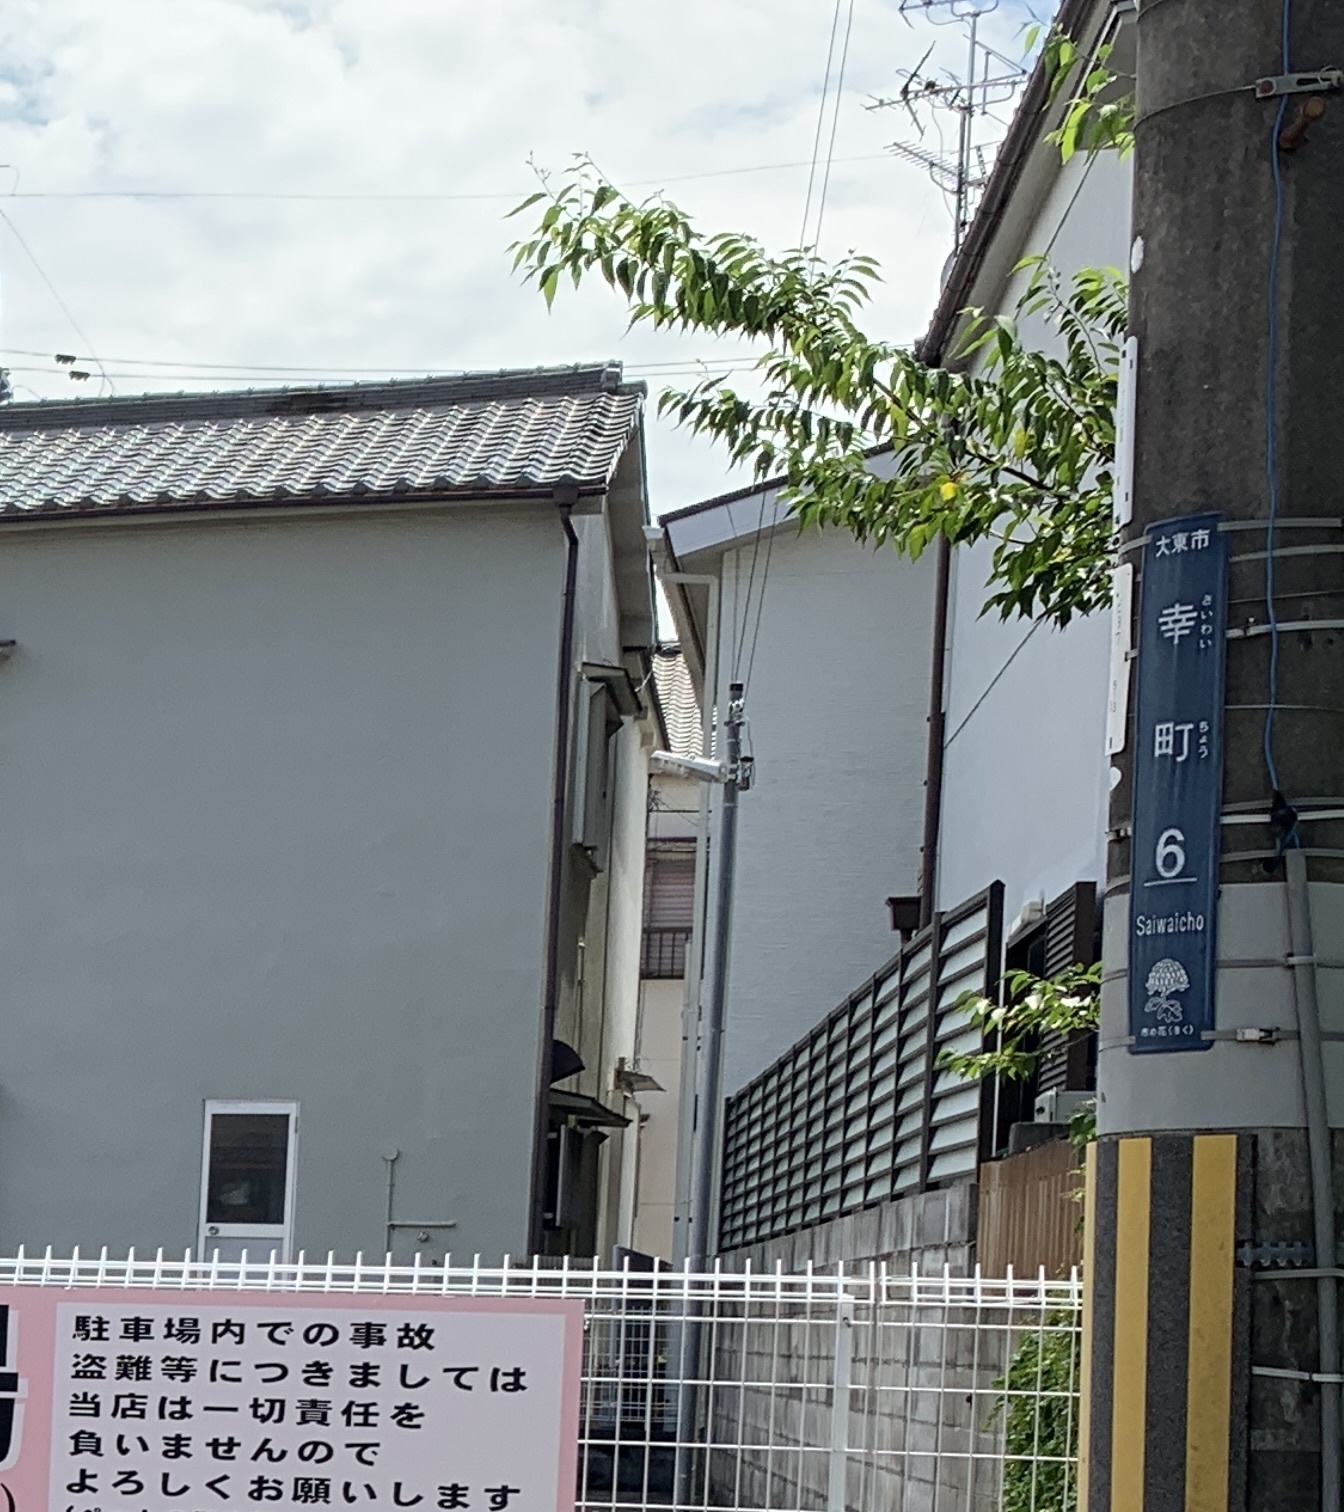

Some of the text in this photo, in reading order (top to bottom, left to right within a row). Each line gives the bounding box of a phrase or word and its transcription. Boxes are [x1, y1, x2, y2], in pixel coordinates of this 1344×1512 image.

[1155, 528, 1211, 558] 大東市
[1200, 594, 1213, 649] さいわい
[1155, 828, 1186, 878] 6
[1136, 911, 1205, 937] Saiwaicho
[72, 1314, 436, 1351] 駐車場内での事故
[70, 1353, 529, 1393] 盗難等につきましては
[68, 1392, 426, 1430] 当店は一切責任を
[68, 1429, 381, 1467] 負いませんので
[65, 1468, 522, 1512] よろしくお願いします
